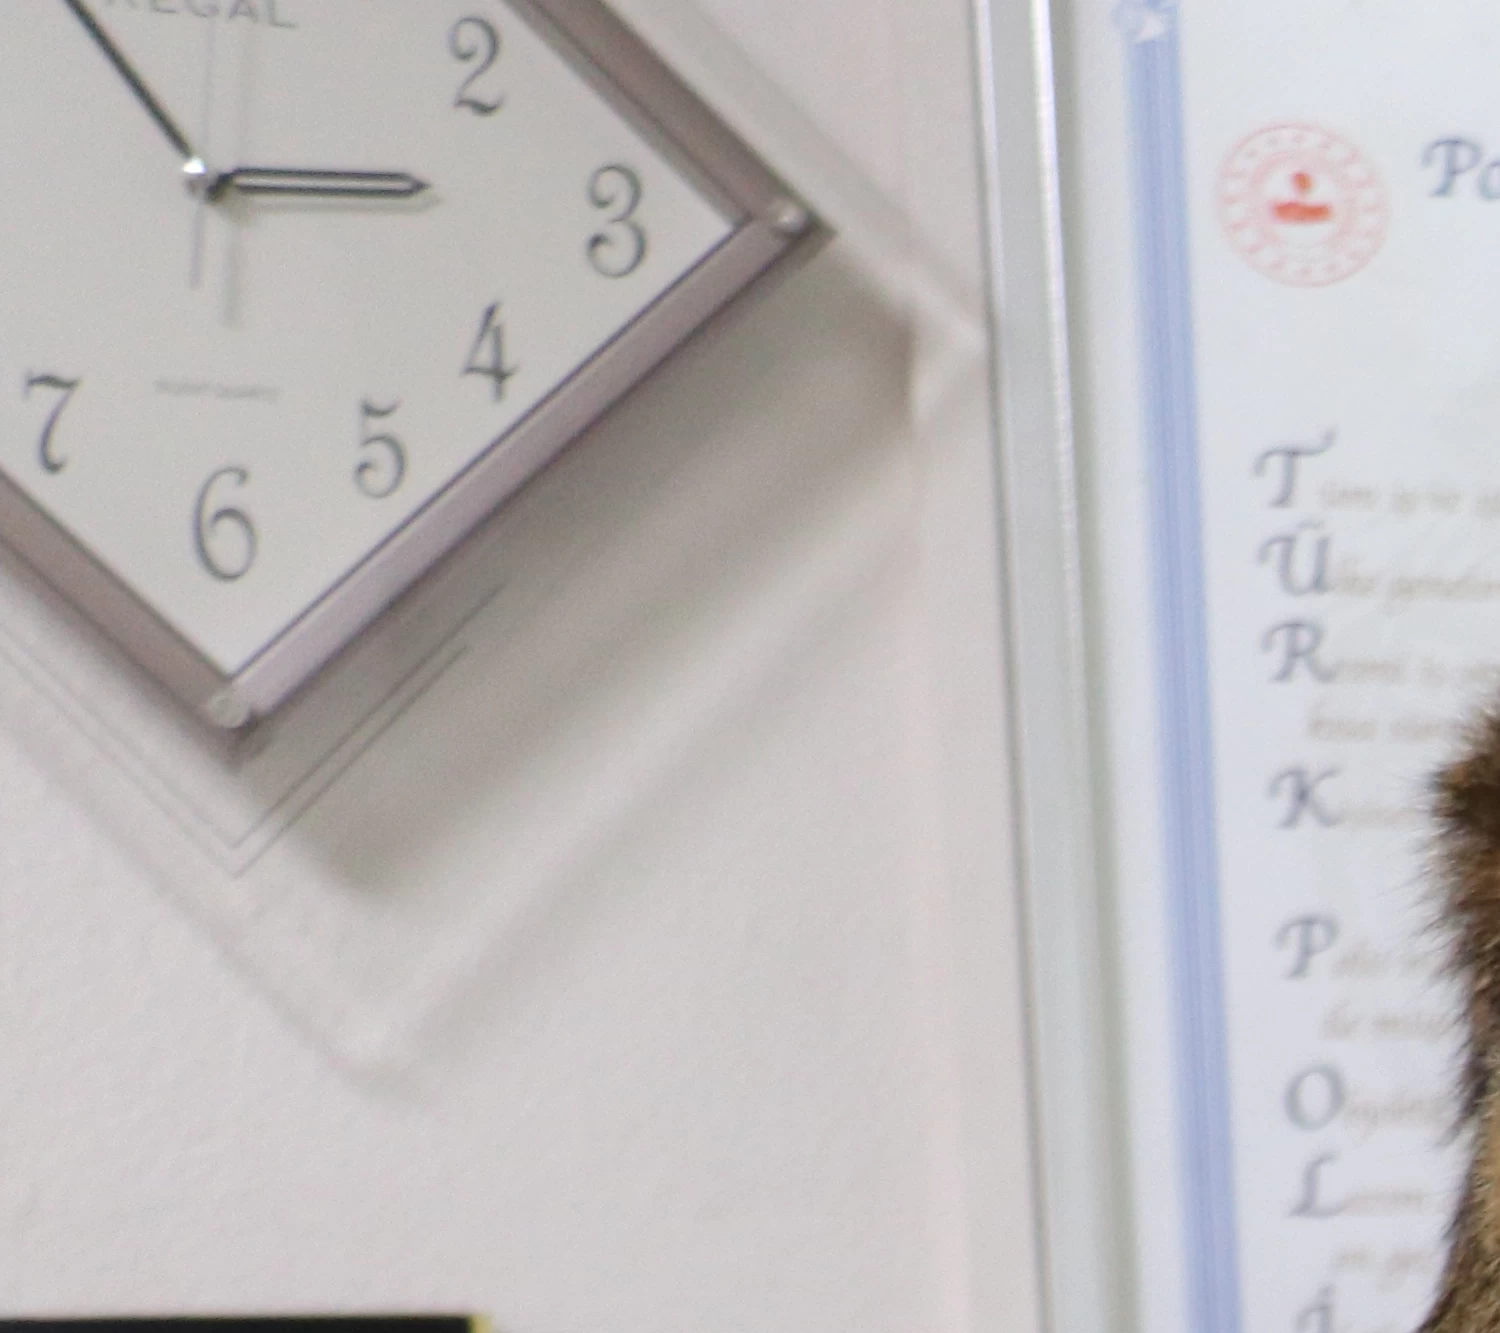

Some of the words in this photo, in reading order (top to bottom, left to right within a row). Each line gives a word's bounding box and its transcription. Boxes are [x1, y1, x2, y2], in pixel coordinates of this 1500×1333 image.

[447, 16, 505, 117] 2
[586, 164, 648, 279] 3
[461, 302, 517, 402] 4
[24, 371, 81, 475] 7
[353, 401, 406, 499] 5
[192, 466, 257, 582] 6
